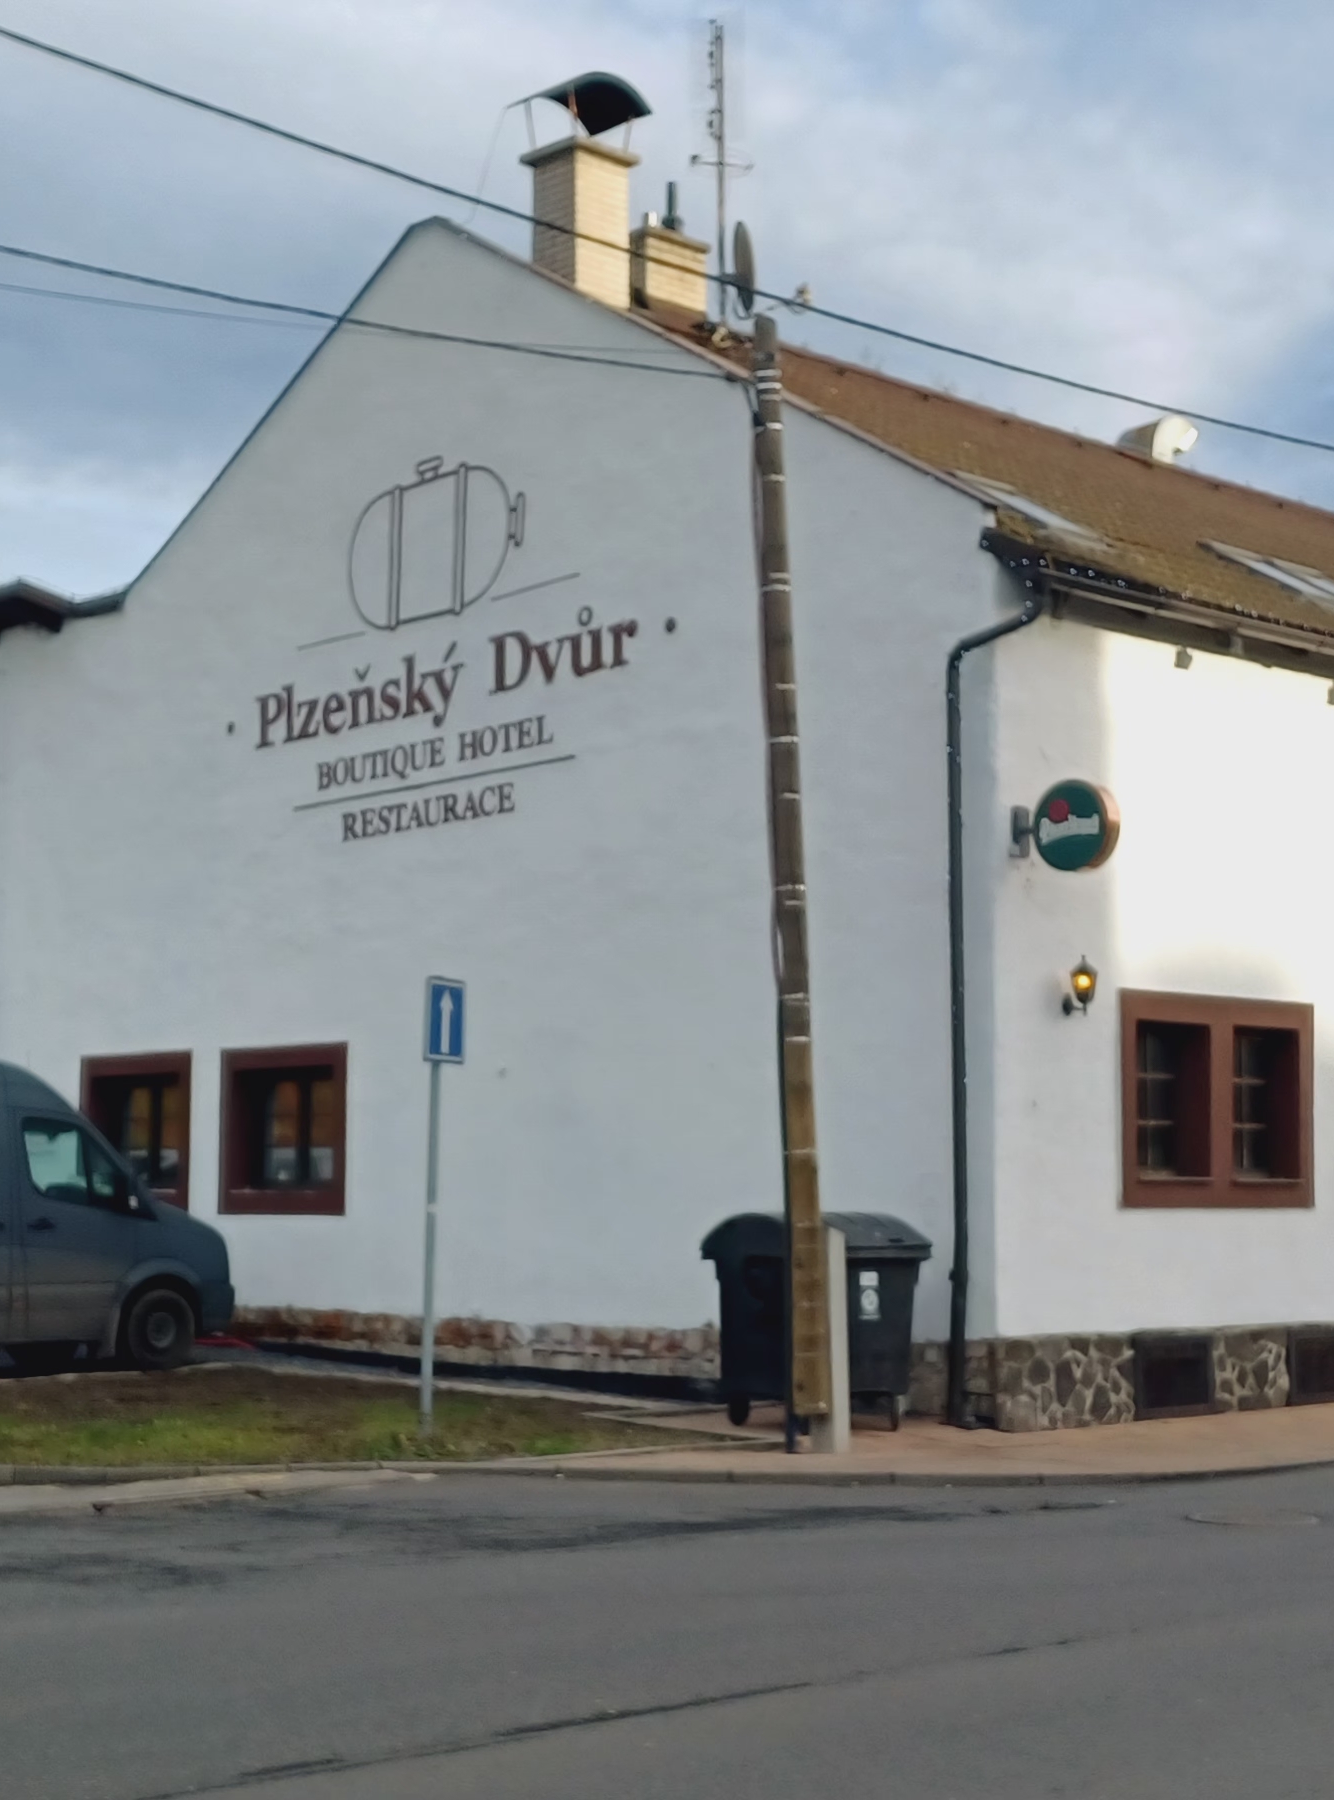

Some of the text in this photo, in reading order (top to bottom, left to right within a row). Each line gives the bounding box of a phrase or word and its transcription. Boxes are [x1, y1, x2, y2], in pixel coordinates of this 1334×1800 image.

[254, 606, 639, 750] Plzeňský Dvůr
[317, 715, 555, 792] BOUTIQUE HOTEL
[342, 782, 517, 843] RESTAURACE
